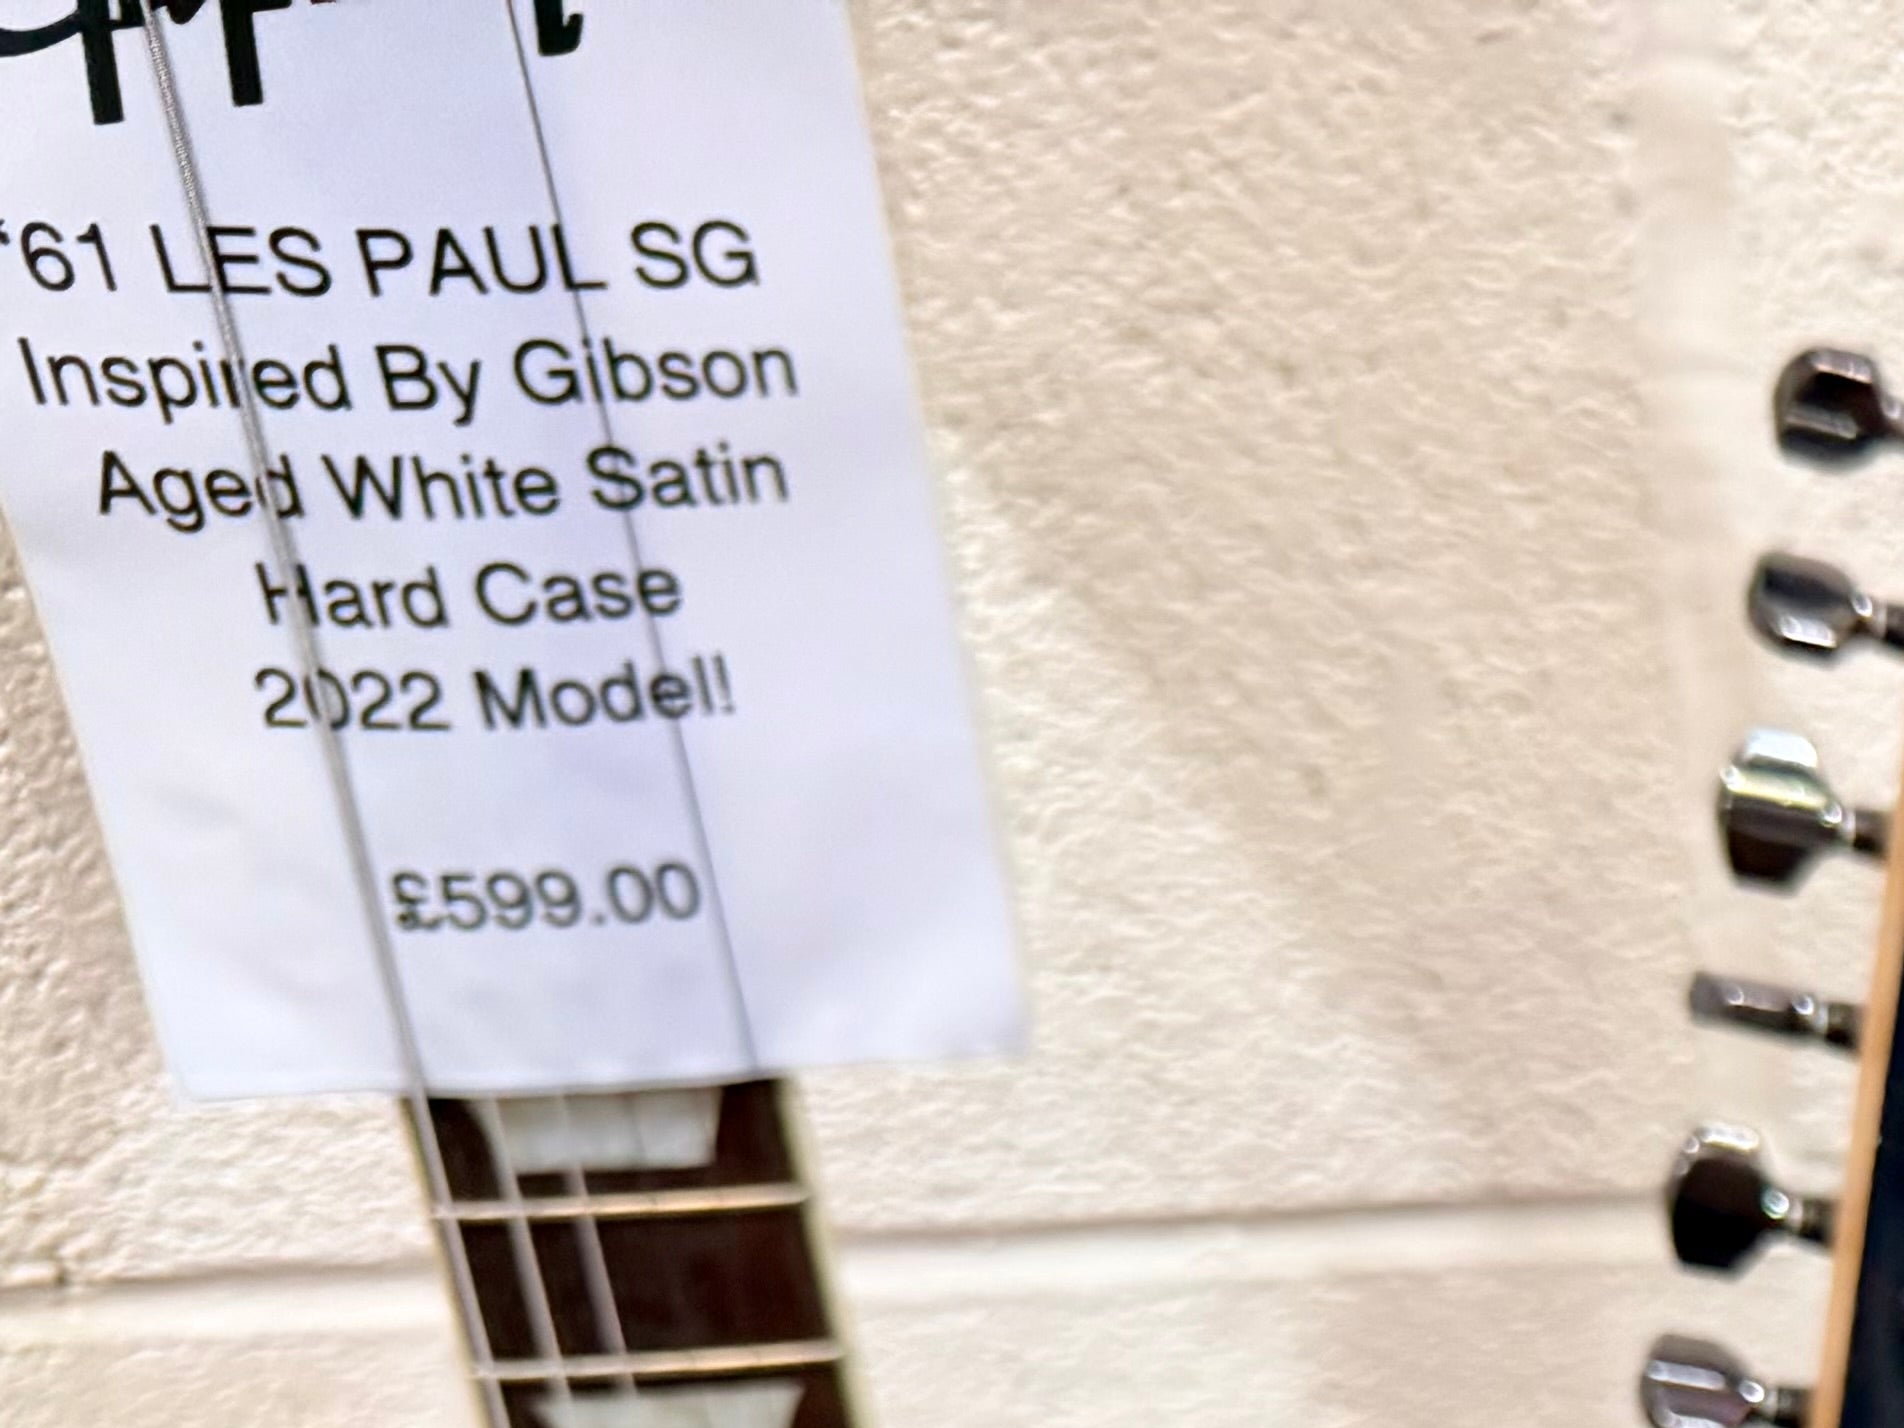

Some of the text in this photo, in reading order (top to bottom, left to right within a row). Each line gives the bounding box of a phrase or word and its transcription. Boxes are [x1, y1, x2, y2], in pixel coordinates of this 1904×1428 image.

[149, 223, 332, 298] LES
[355, 223, 609, 298] PAUL
[630, 219, 761, 291] SG
[17, 336, 798, 425] Inspired By Gibson
[100, 440, 789, 534] Aged White Satin
[255, 560, 683, 628] Hard Case
[255, 652, 736, 731] 2022 Model!
[392, 860, 700, 932] £599.00
